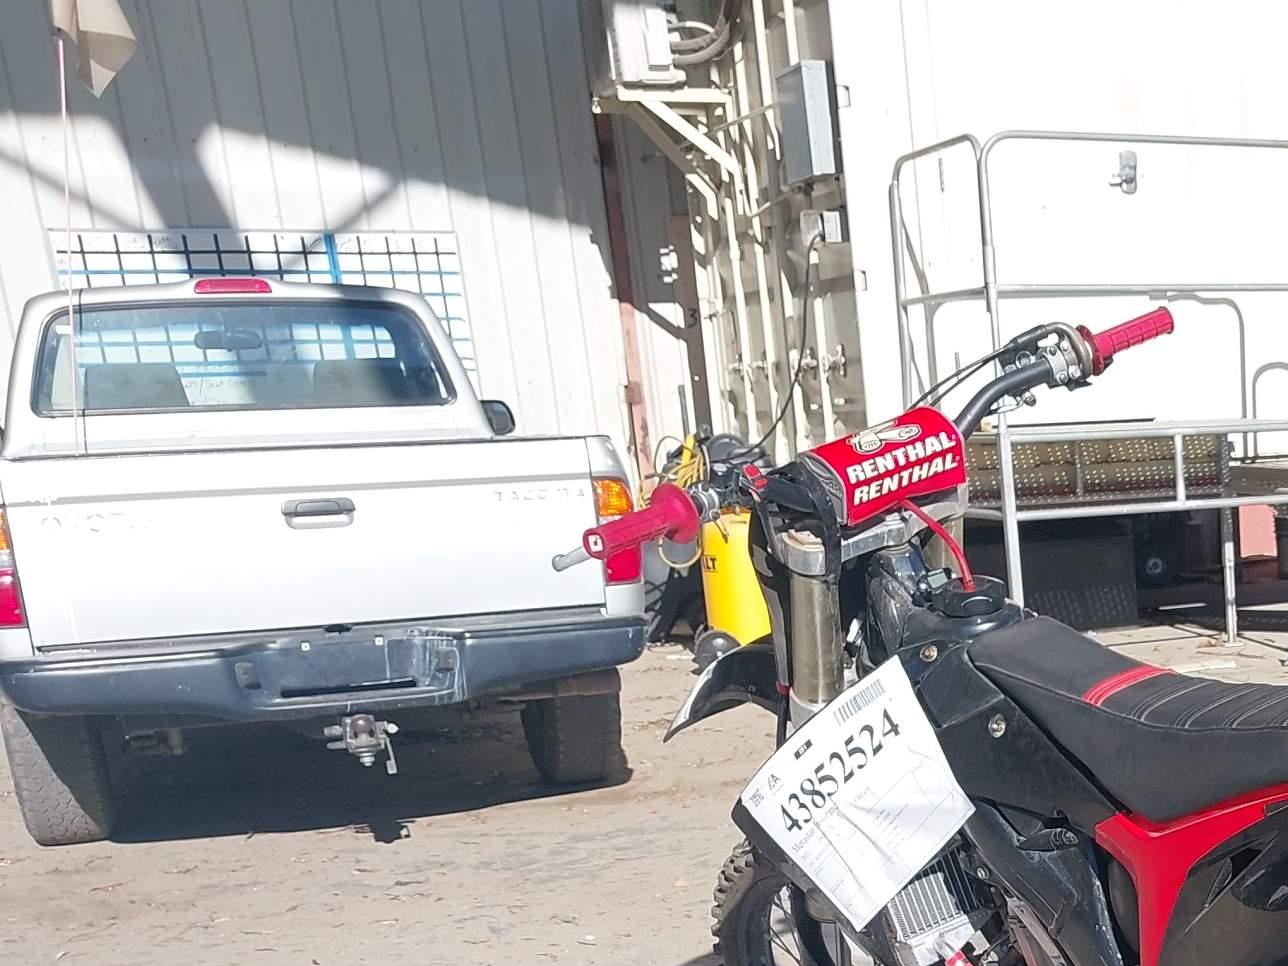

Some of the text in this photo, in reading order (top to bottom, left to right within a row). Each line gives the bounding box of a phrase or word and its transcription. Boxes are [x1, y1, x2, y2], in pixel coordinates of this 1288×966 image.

[846, 431, 957, 485] RENTHAL
[853, 452, 959, 506] RENTHAL
[781, 707, 900, 832] 43852524
